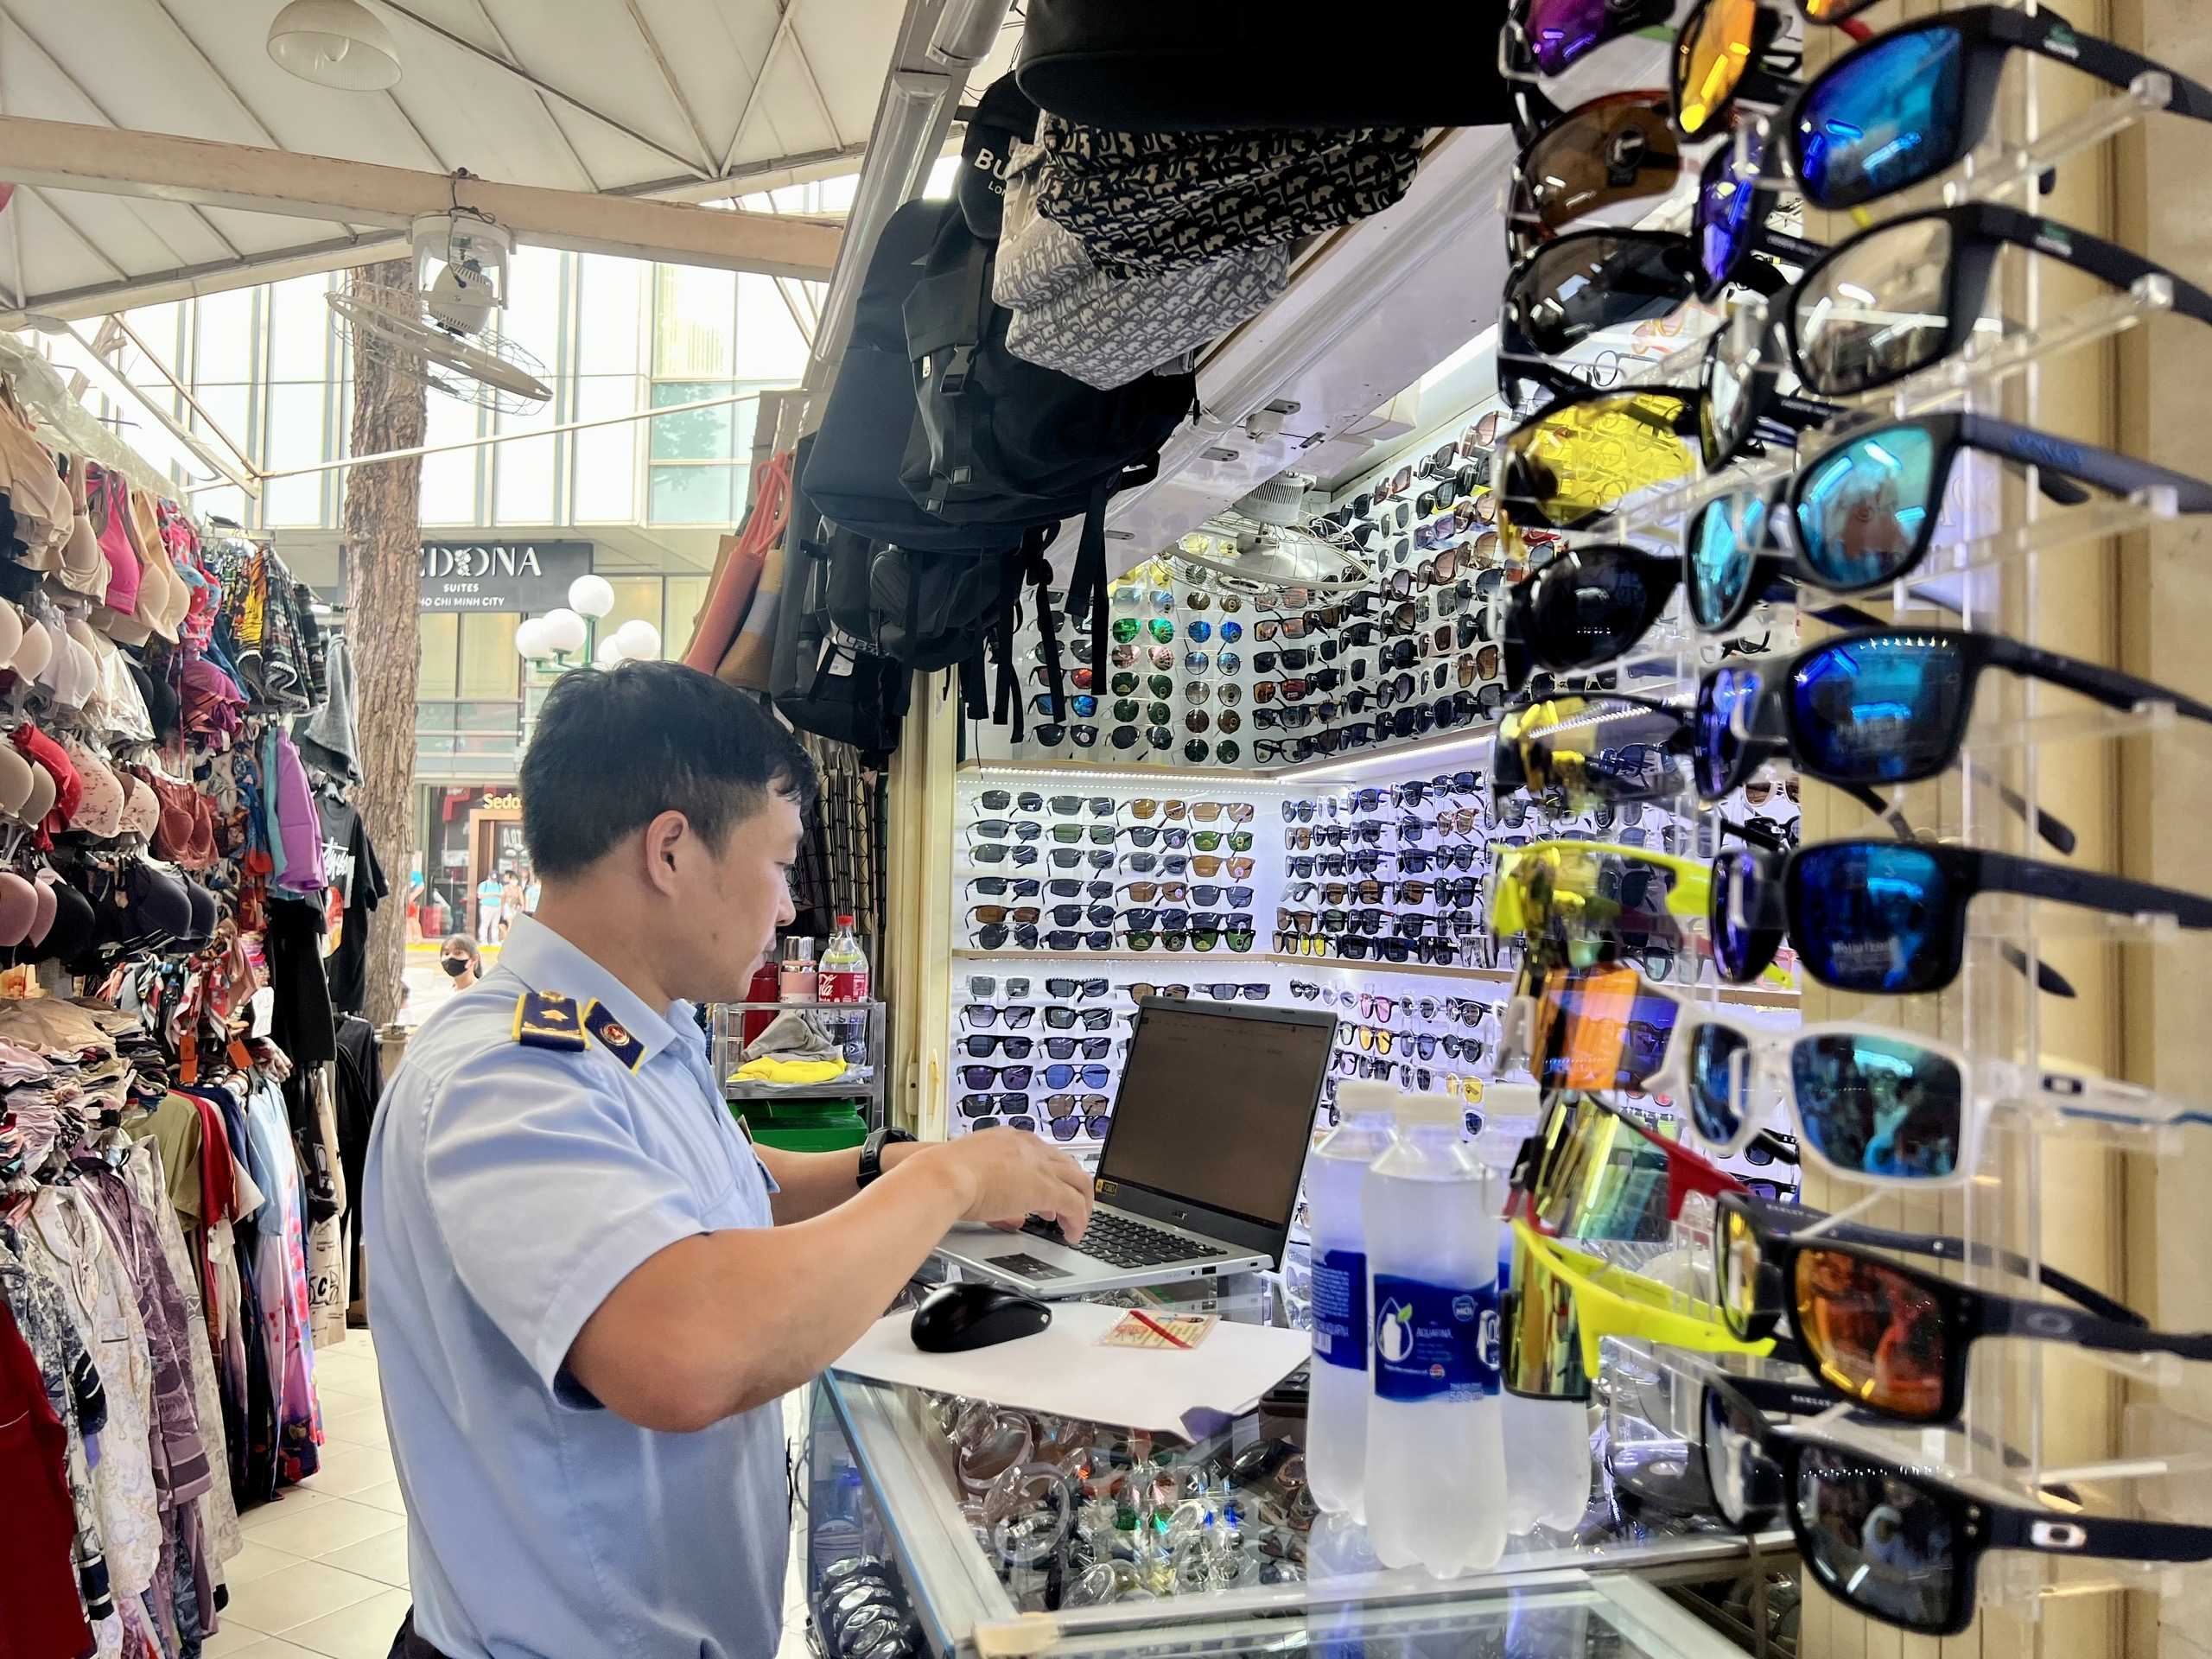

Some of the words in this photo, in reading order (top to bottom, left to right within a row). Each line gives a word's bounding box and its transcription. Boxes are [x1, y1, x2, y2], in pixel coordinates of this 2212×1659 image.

[419, 546, 542, 577] DONA
[443, 583, 480, 593] SUITES
[434, 597, 451, 607] CHI
[454, 597, 480, 607] MINH
[482, 596, 505, 607] CITY
[483, 792, 522, 810] Sedo
